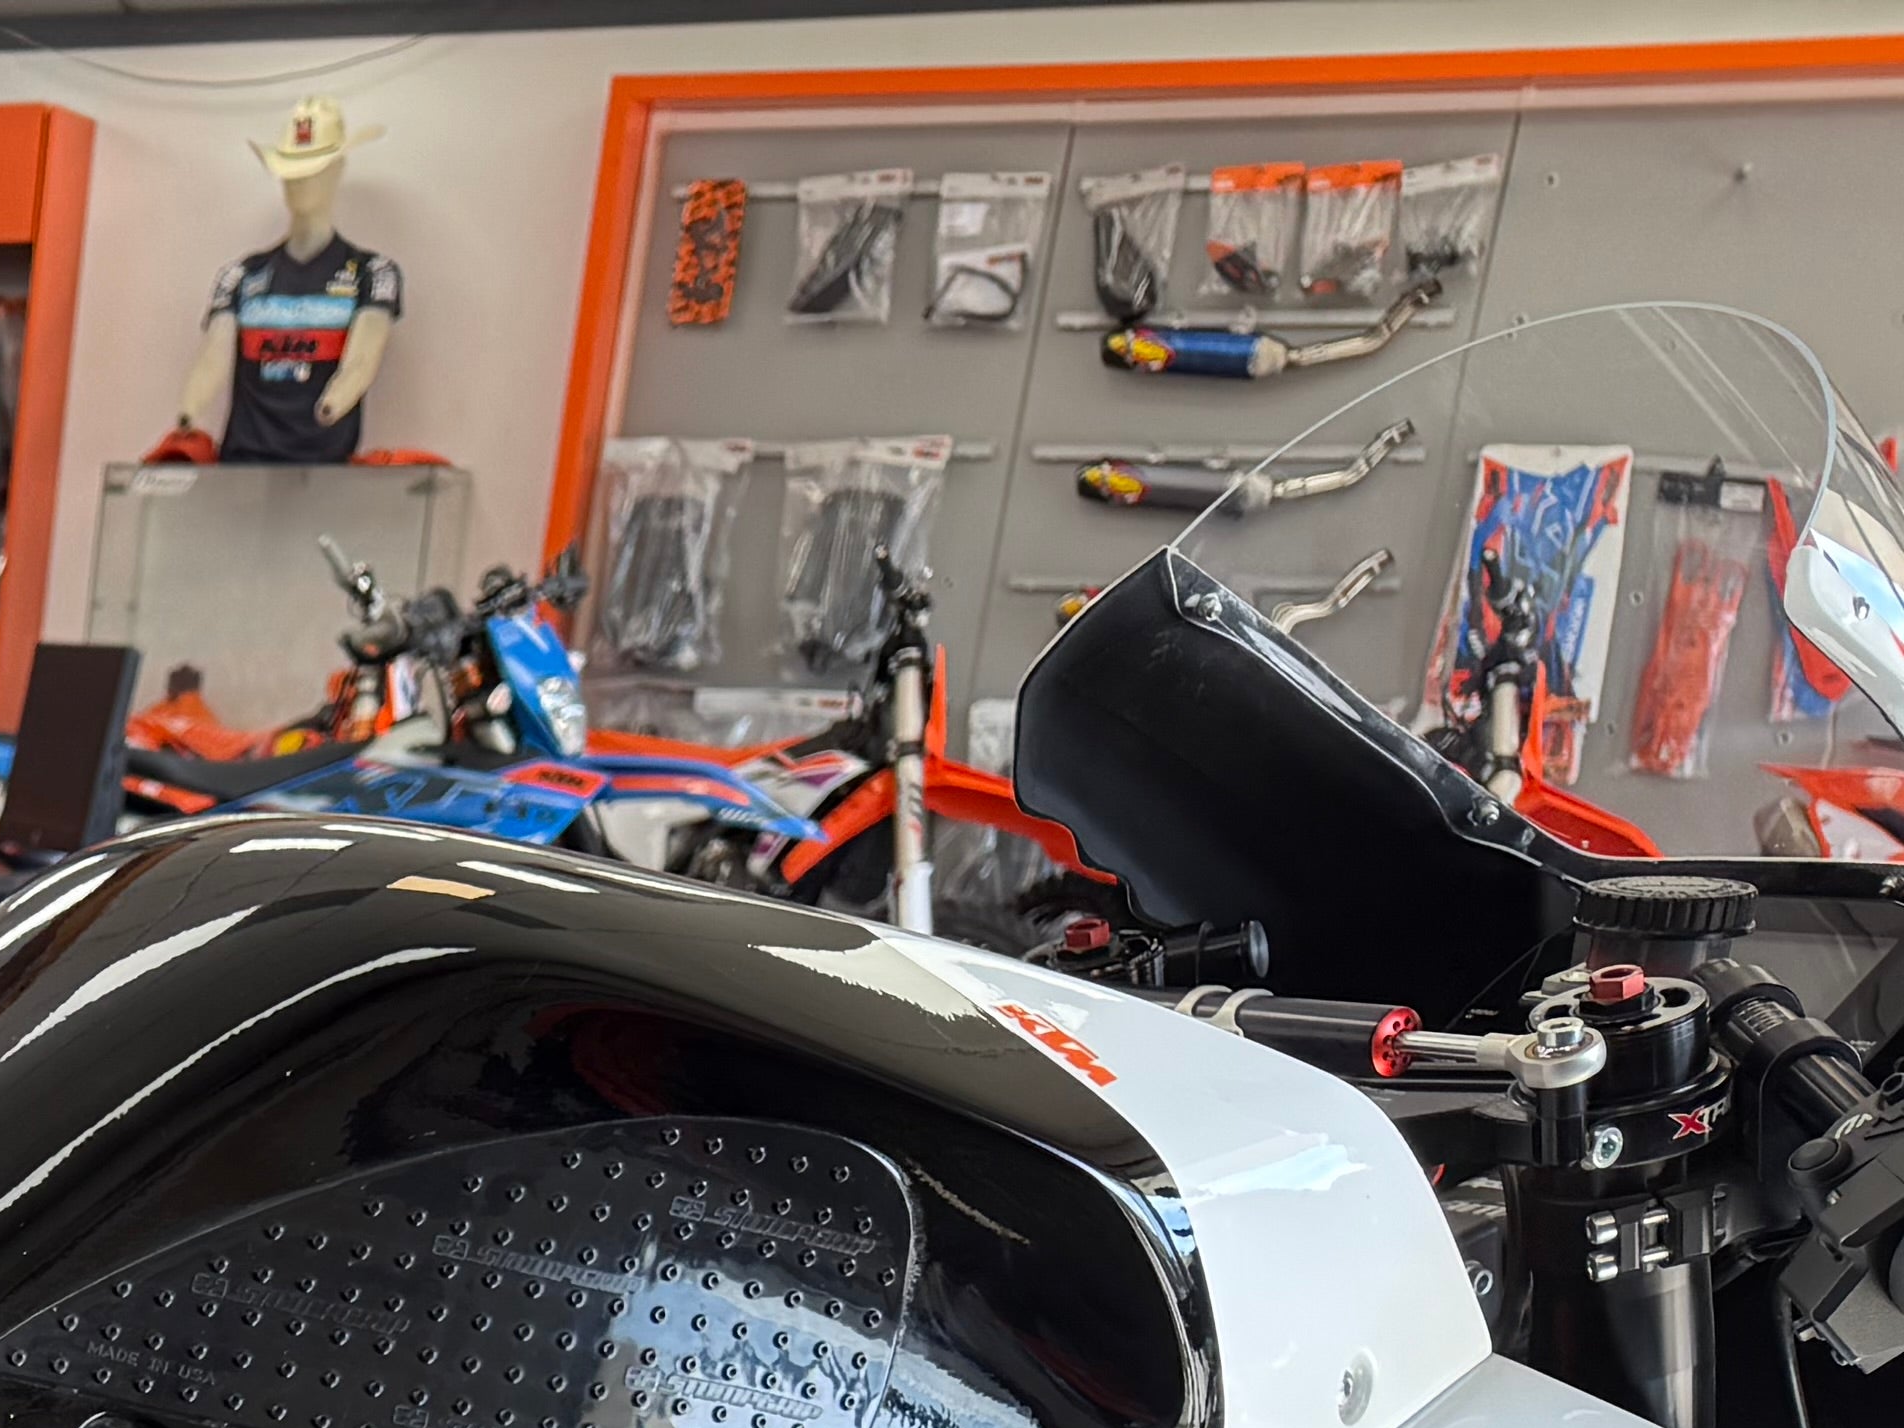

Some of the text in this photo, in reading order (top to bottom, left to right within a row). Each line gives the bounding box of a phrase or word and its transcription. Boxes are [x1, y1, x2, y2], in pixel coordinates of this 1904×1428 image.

[991, 1003, 1118, 1088] KTM
[85, 1339, 216, 1388] MADE IN USA
